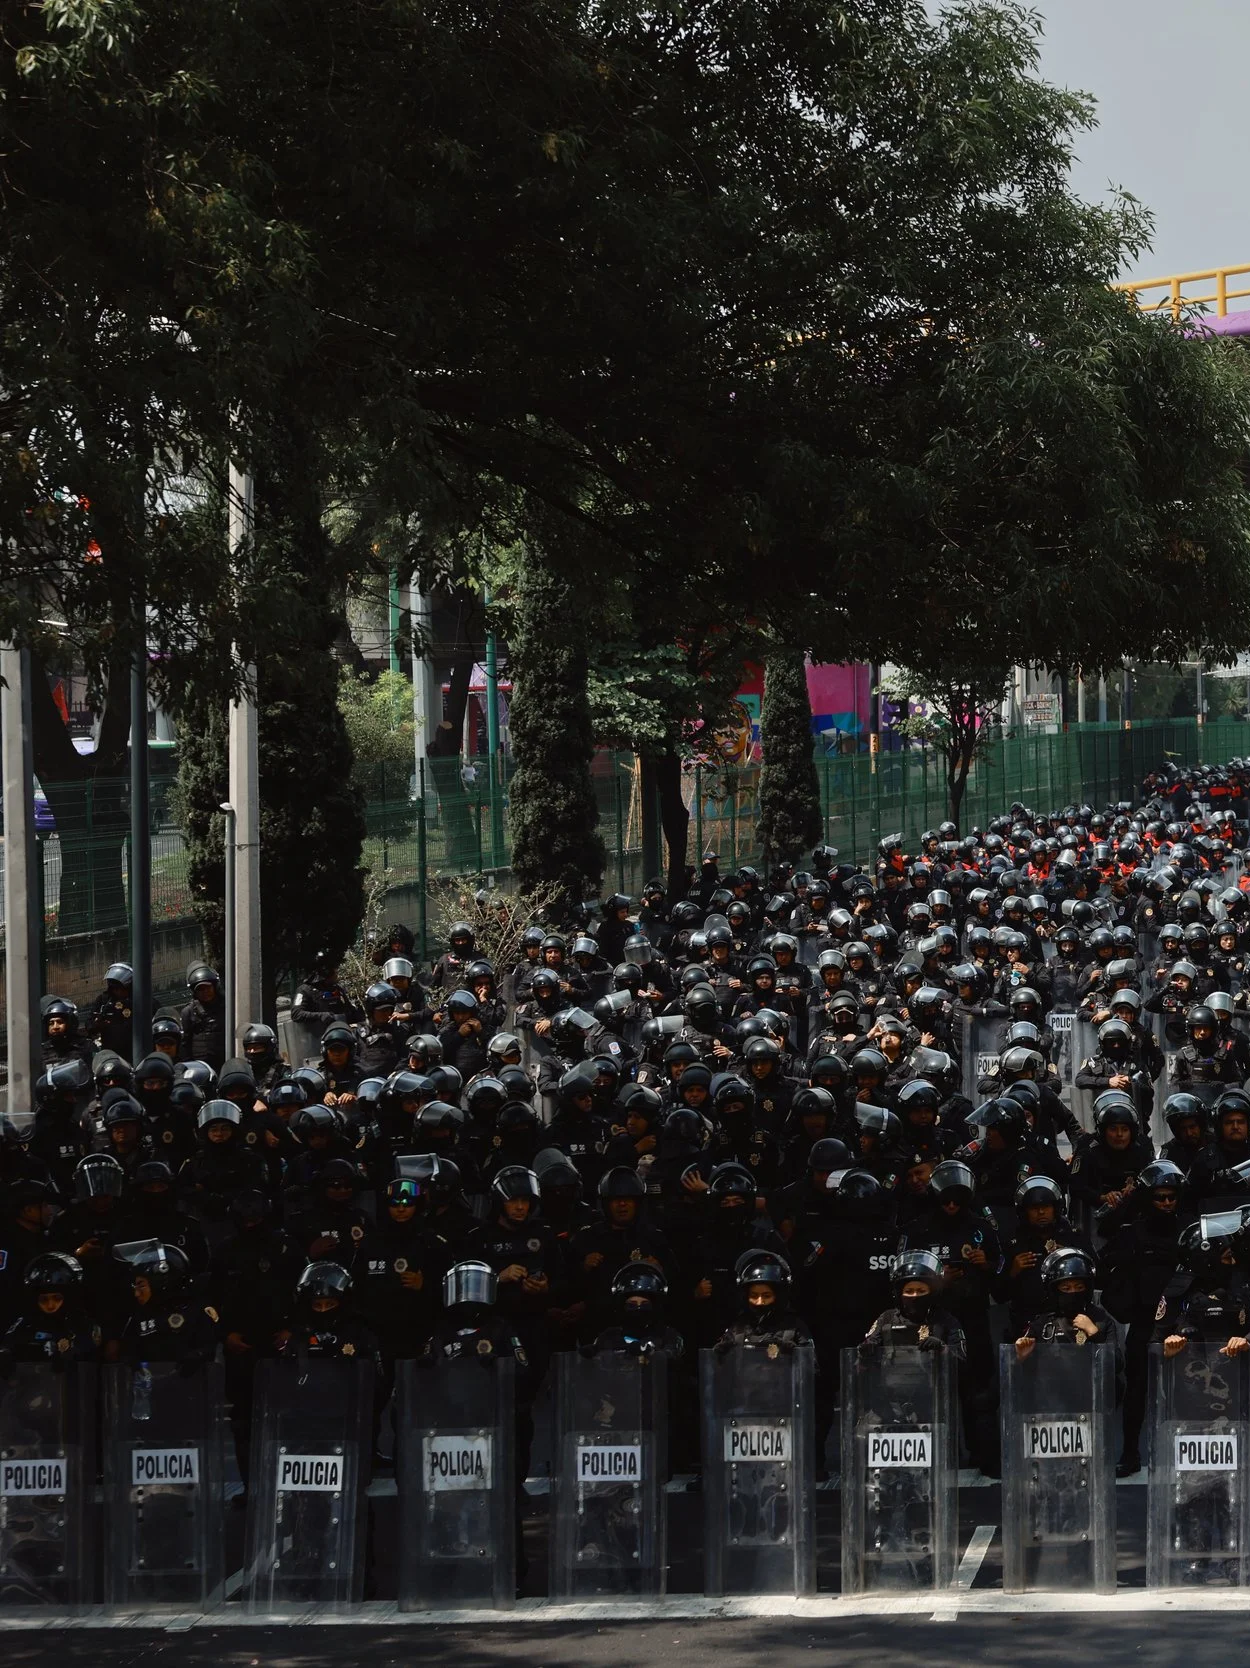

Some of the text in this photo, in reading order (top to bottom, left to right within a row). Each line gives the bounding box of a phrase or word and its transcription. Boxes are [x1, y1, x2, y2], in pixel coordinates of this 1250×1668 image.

[1051, 1017, 1072, 1029] POLIC
[731, 1431, 784, 1457] POLICIA
[872, 1439, 927, 1462] POLICIA
[1030, 1426, 1084, 1454] POLICIA
[430, 1450, 484, 1477] POLICIA
[581, 1452, 637, 1476] POLICIA
[1179, 1441, 1234, 1465] POLICIA
[4, 1465, 62, 1490] POLICIA
[136, 1455, 194, 1480] POLICIA
[282, 1461, 338, 1486] POLICIA
